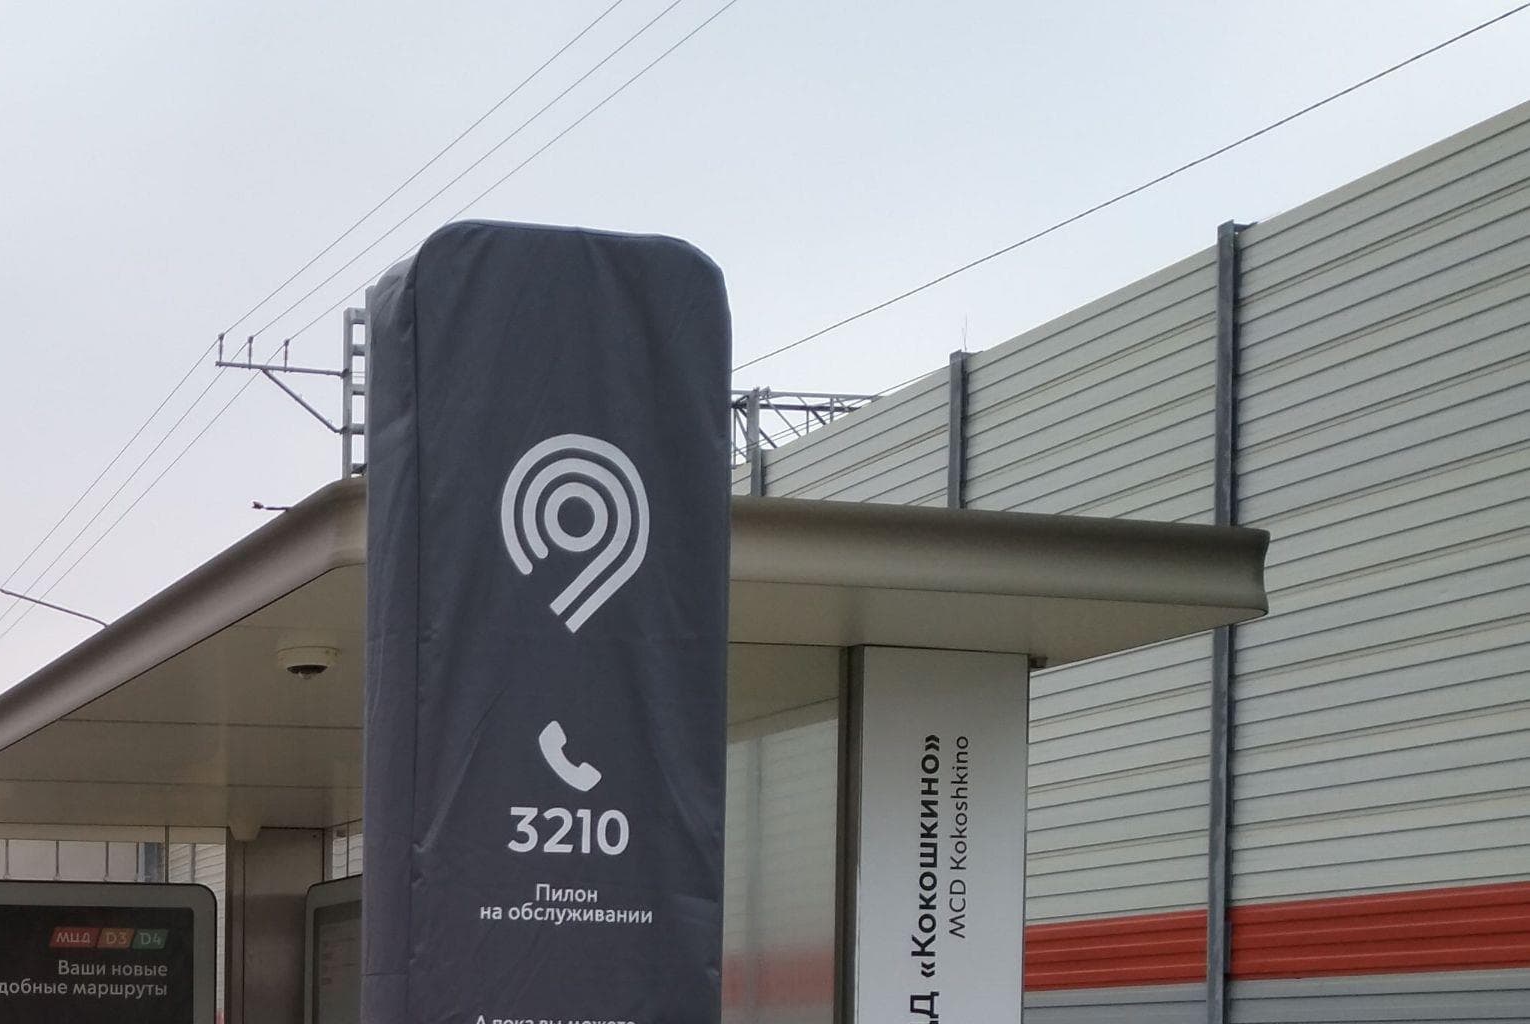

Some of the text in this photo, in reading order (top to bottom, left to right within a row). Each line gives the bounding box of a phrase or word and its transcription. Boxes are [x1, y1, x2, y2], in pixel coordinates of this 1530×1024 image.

[508, 807, 630, 856] 3210
[948, 735, 969, 939] MCD Kokoshkino
[911, 734, 940, 979] «Кокошкино»
[536, 883, 598, 902] Пилон
[480, 902, 653, 925] на обслуживании
[56, 931, 162, 945] МЦД D3 D4
[58, 960, 168, 977] Ваши новые
[72, 983, 168, 1000] маршруты
